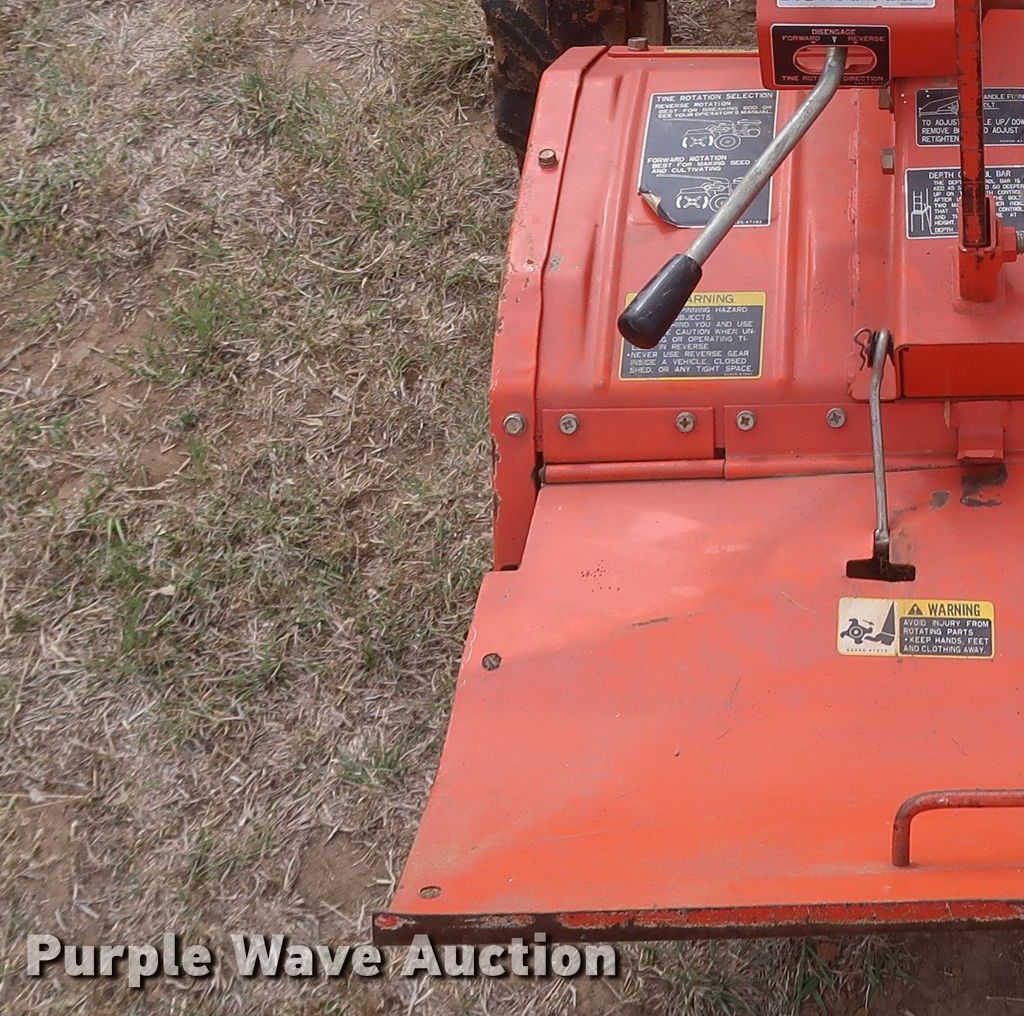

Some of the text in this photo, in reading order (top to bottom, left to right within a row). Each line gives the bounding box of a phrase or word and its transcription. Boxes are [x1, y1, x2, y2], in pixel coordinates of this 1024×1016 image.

[671, 166, 722, 174] CULTIVATING
[929, 172, 955, 180] DEPTH
[689, 295, 735, 304] ARNING
[728, 350, 750, 358] GEAR
[714, 358, 747, 366] CLOSED
[928, 603, 981, 617] WARNING
[903, 619, 927, 627] AVOID
[933, 620, 961, 628] INJURY
[903, 628, 943, 636] ROTATING
[922, 646, 962, 654] CLOTHING
